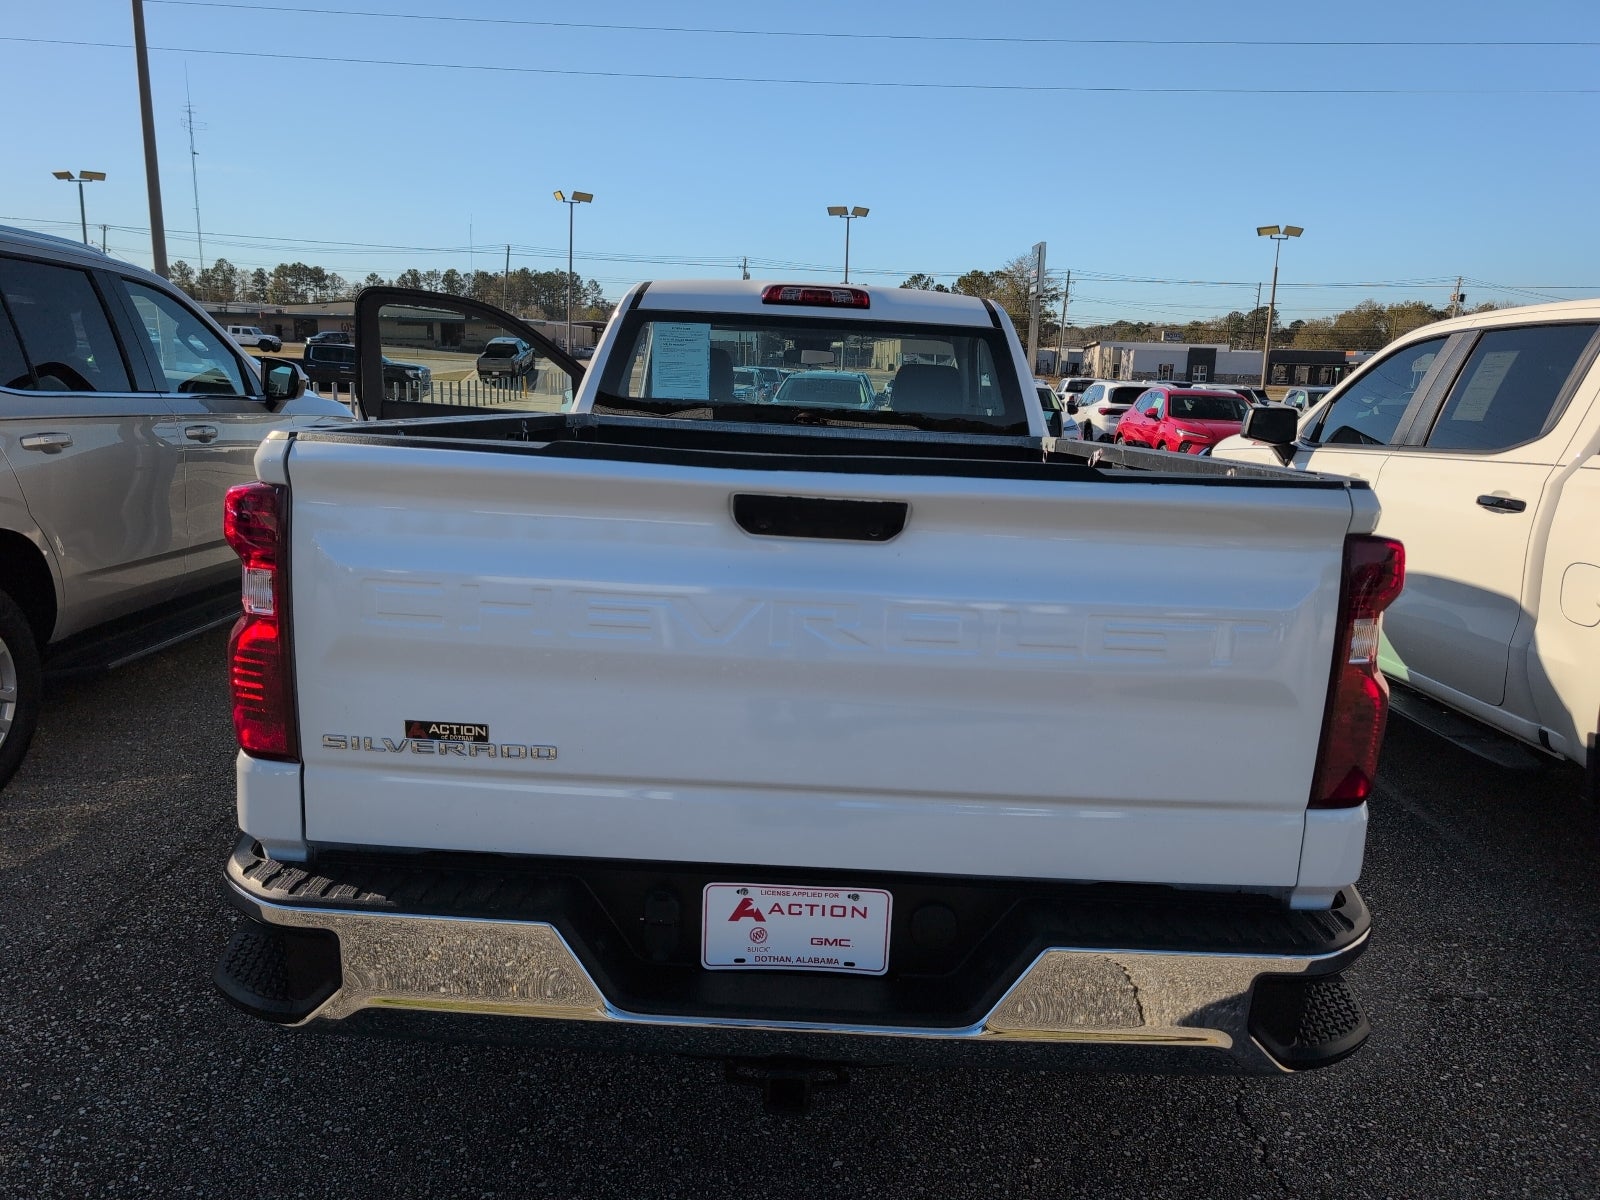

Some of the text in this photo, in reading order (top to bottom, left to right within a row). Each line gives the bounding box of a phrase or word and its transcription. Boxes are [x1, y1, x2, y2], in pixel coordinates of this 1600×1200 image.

[361, 578, 1272, 666] CHEVROLET
[428, 723, 487, 736] ACTION
[322, 733, 558, 761] SILVERADO
[760, 889, 791, 897] LICENSE
[767, 902, 868, 919] ACTION
[810, 937, 851, 948] GMC
[754, 955, 840, 966] DOTHAN, ALABAMA
